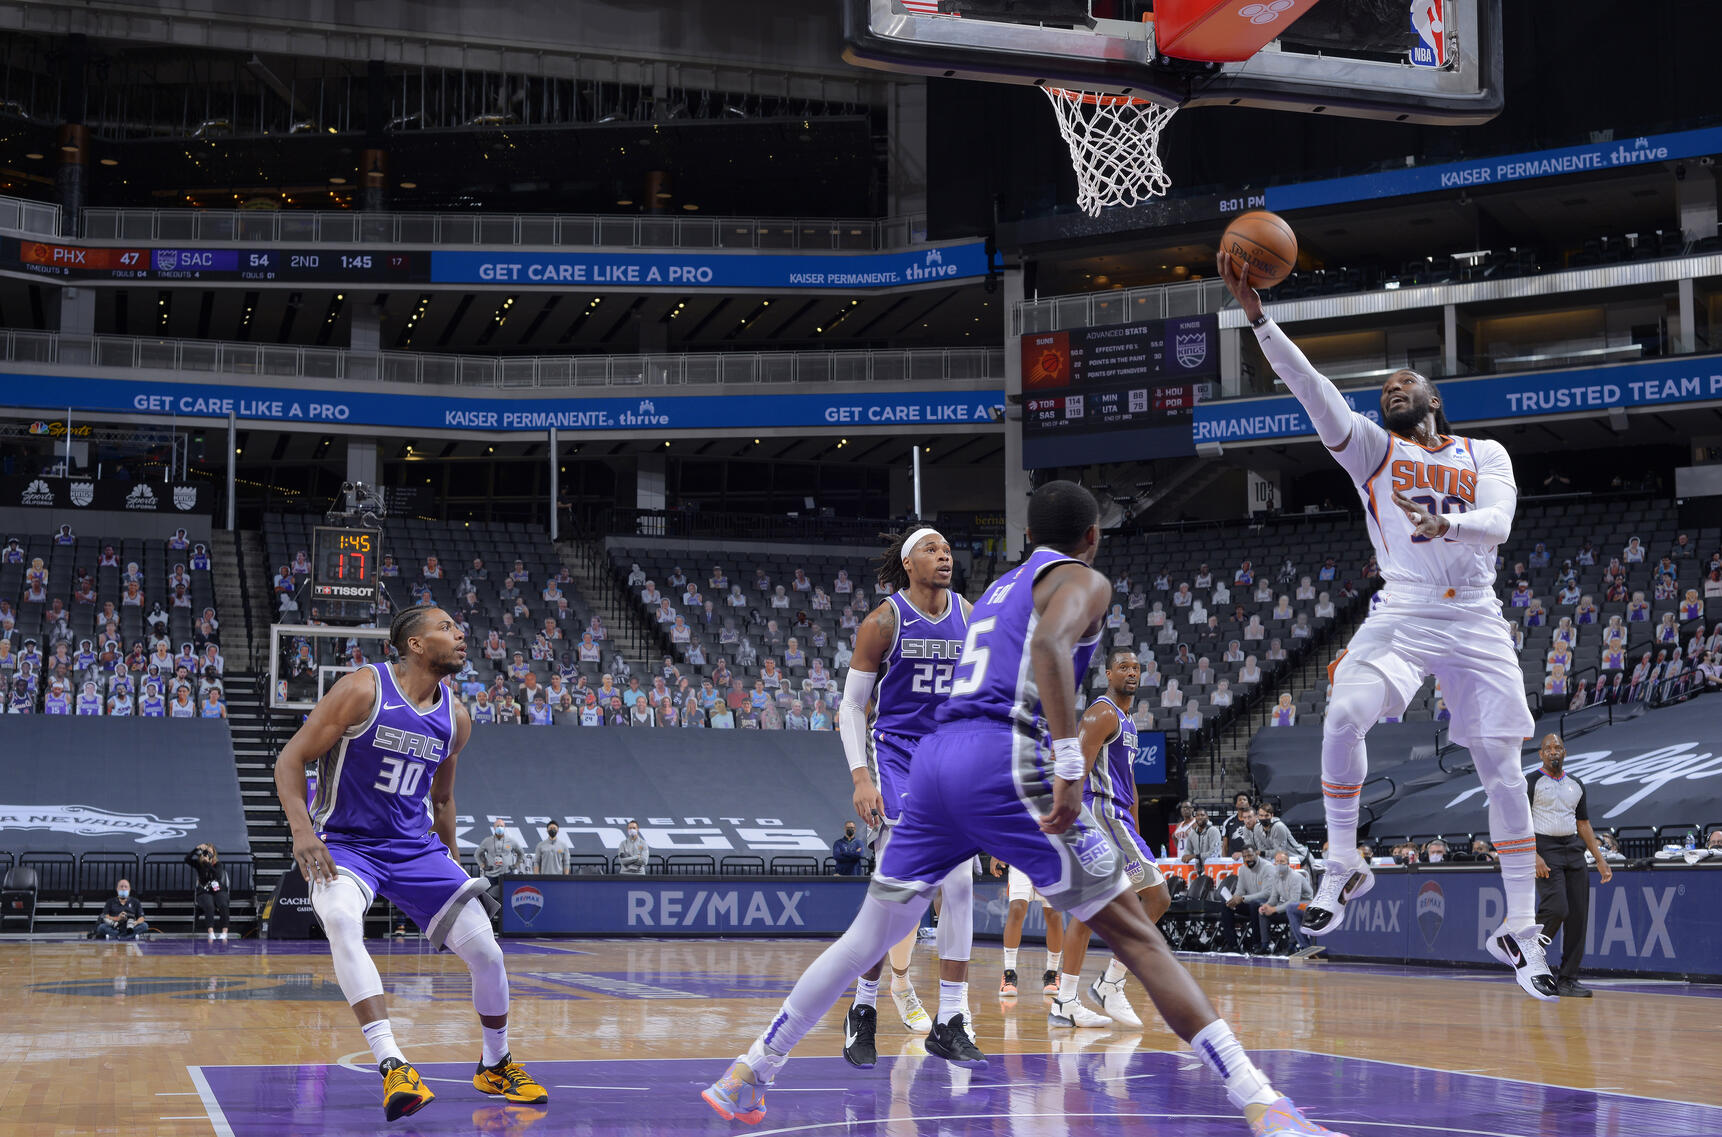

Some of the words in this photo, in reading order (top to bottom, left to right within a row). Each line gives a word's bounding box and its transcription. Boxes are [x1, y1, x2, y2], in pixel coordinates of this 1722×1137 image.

[1414, 48, 1432, 62] NBA
[1441, 168, 1490, 187] KAISER
[1610, 146, 1668, 164] thrive
[1220, 198, 1244, 212] 8:01
[1248, 195, 1265, 208] PM
[54, 248, 86, 264] PHX
[120, 253, 139, 265] 47
[181, 253, 212, 266] SAC
[250, 254, 269, 266] 54
[290, 256, 319, 267] 2ND
[341, 256, 372, 268] 1:45
[1230, 242, 1278, 278] SPALDING
[26, 264, 60, 274] TIMEOUTS
[479, 264, 522, 280] GET
[528, 265, 586, 281] CARE
[593, 265, 640, 281] LIKE
[646, 266, 662, 281] A
[669, 266, 713, 282] PRO
[790, 273, 824, 283] KAISER
[906, 263, 957, 280] thrive
[1086, 330, 1124, 339] ADVANCED
[1125, 327, 1148, 335] STATS
[1096, 344, 1125, 353] EFFECTIVE
[1178, 346, 1204, 356] KINGS
[1102, 394, 1118, 402] MIN
[1165, 388, 1183, 396] HOU
[1506, 385, 1621, 411] TRUSTED
[1628, 377, 1701, 400] TEAM
[1710, 375, 1722, 394] P
[134, 395, 174, 410] GET
[179, 398, 233, 413] CARE
[240, 400, 283, 416] LIKE
[288, 403, 303, 417] A
[310, 404, 349, 420] PRO
[1039, 400, 1055, 408] TOR
[1165, 399, 1182, 407] POR
[445, 410, 497, 426] KAISER
[619, 410, 669, 425] thrive
[825, 407, 862, 421] GET
[868, 406, 920, 421] CARE
[926, 405, 968, 420] LIKE
[974, 405, 988, 419] A
[1039, 411, 1055, 419] SAS
[48, 422, 92, 438] Sports
[1193, 413, 1299, 439] ERMANENTE
[1392, 460, 1477, 504] SUNS
[22, 490, 55, 502] Sports
[1255, 480, 1274, 502] 103
[126, 494, 159, 505] Sports
[340, 535, 370, 552] 1:45
[339, 552, 365, 580] 17
[332, 586, 374, 596] TISSOT
[901, 638, 965, 659] SAC
[950, 615, 998, 698] 5
[912, 663, 955, 694] 22
[372, 724, 444, 762] SAC
[1123, 731, 1138, 750] SA
[374, 755, 426, 796] 30
[29, 815, 150, 830] NEVADA
[456, 814, 784, 826] ACRAMENTO
[1080, 840, 1110, 866] SAC
[627, 890, 804, 926] RE/MAX
[1337, 900, 1401, 932] /MAX
[1478, 886, 1676, 958] RAX
